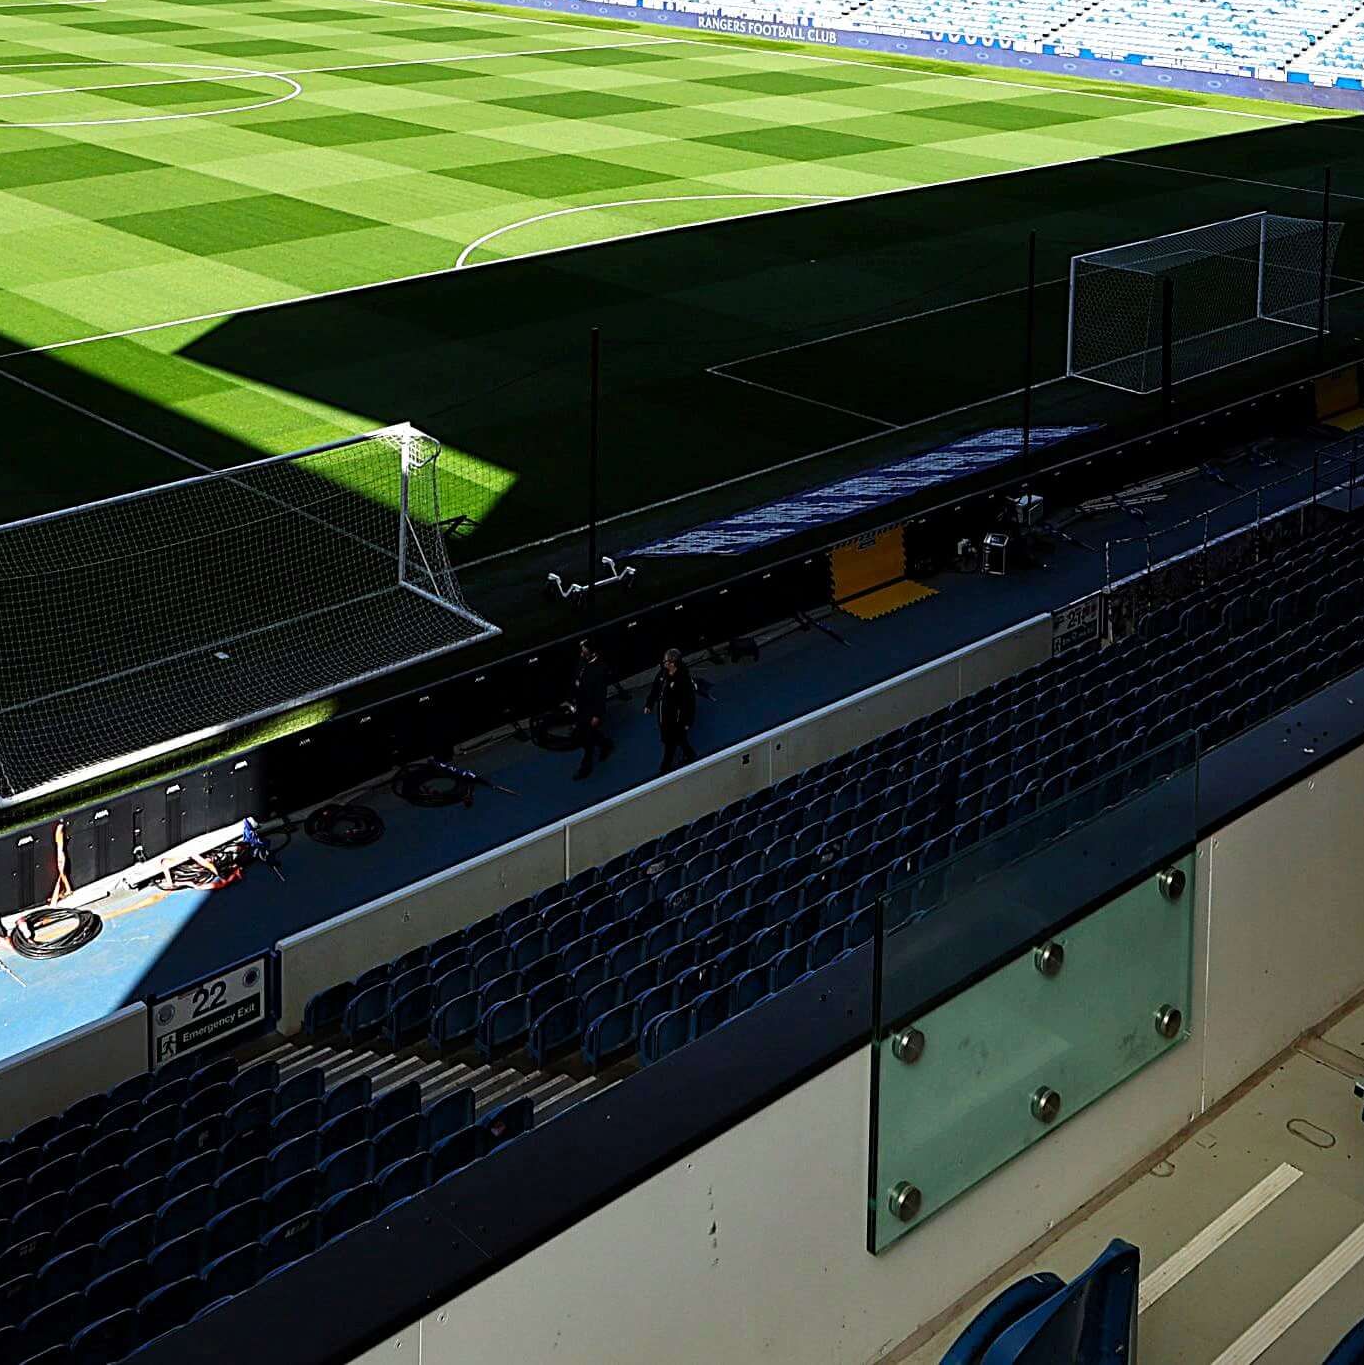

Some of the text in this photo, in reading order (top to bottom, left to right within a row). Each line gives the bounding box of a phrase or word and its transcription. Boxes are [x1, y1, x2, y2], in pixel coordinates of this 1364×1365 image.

[698, 15, 838, 44] RANGERS FOOTBALL CLUB
[192, 981, 227, 1018] 22
[183, 1002, 255, 1043] Emergency Exit
